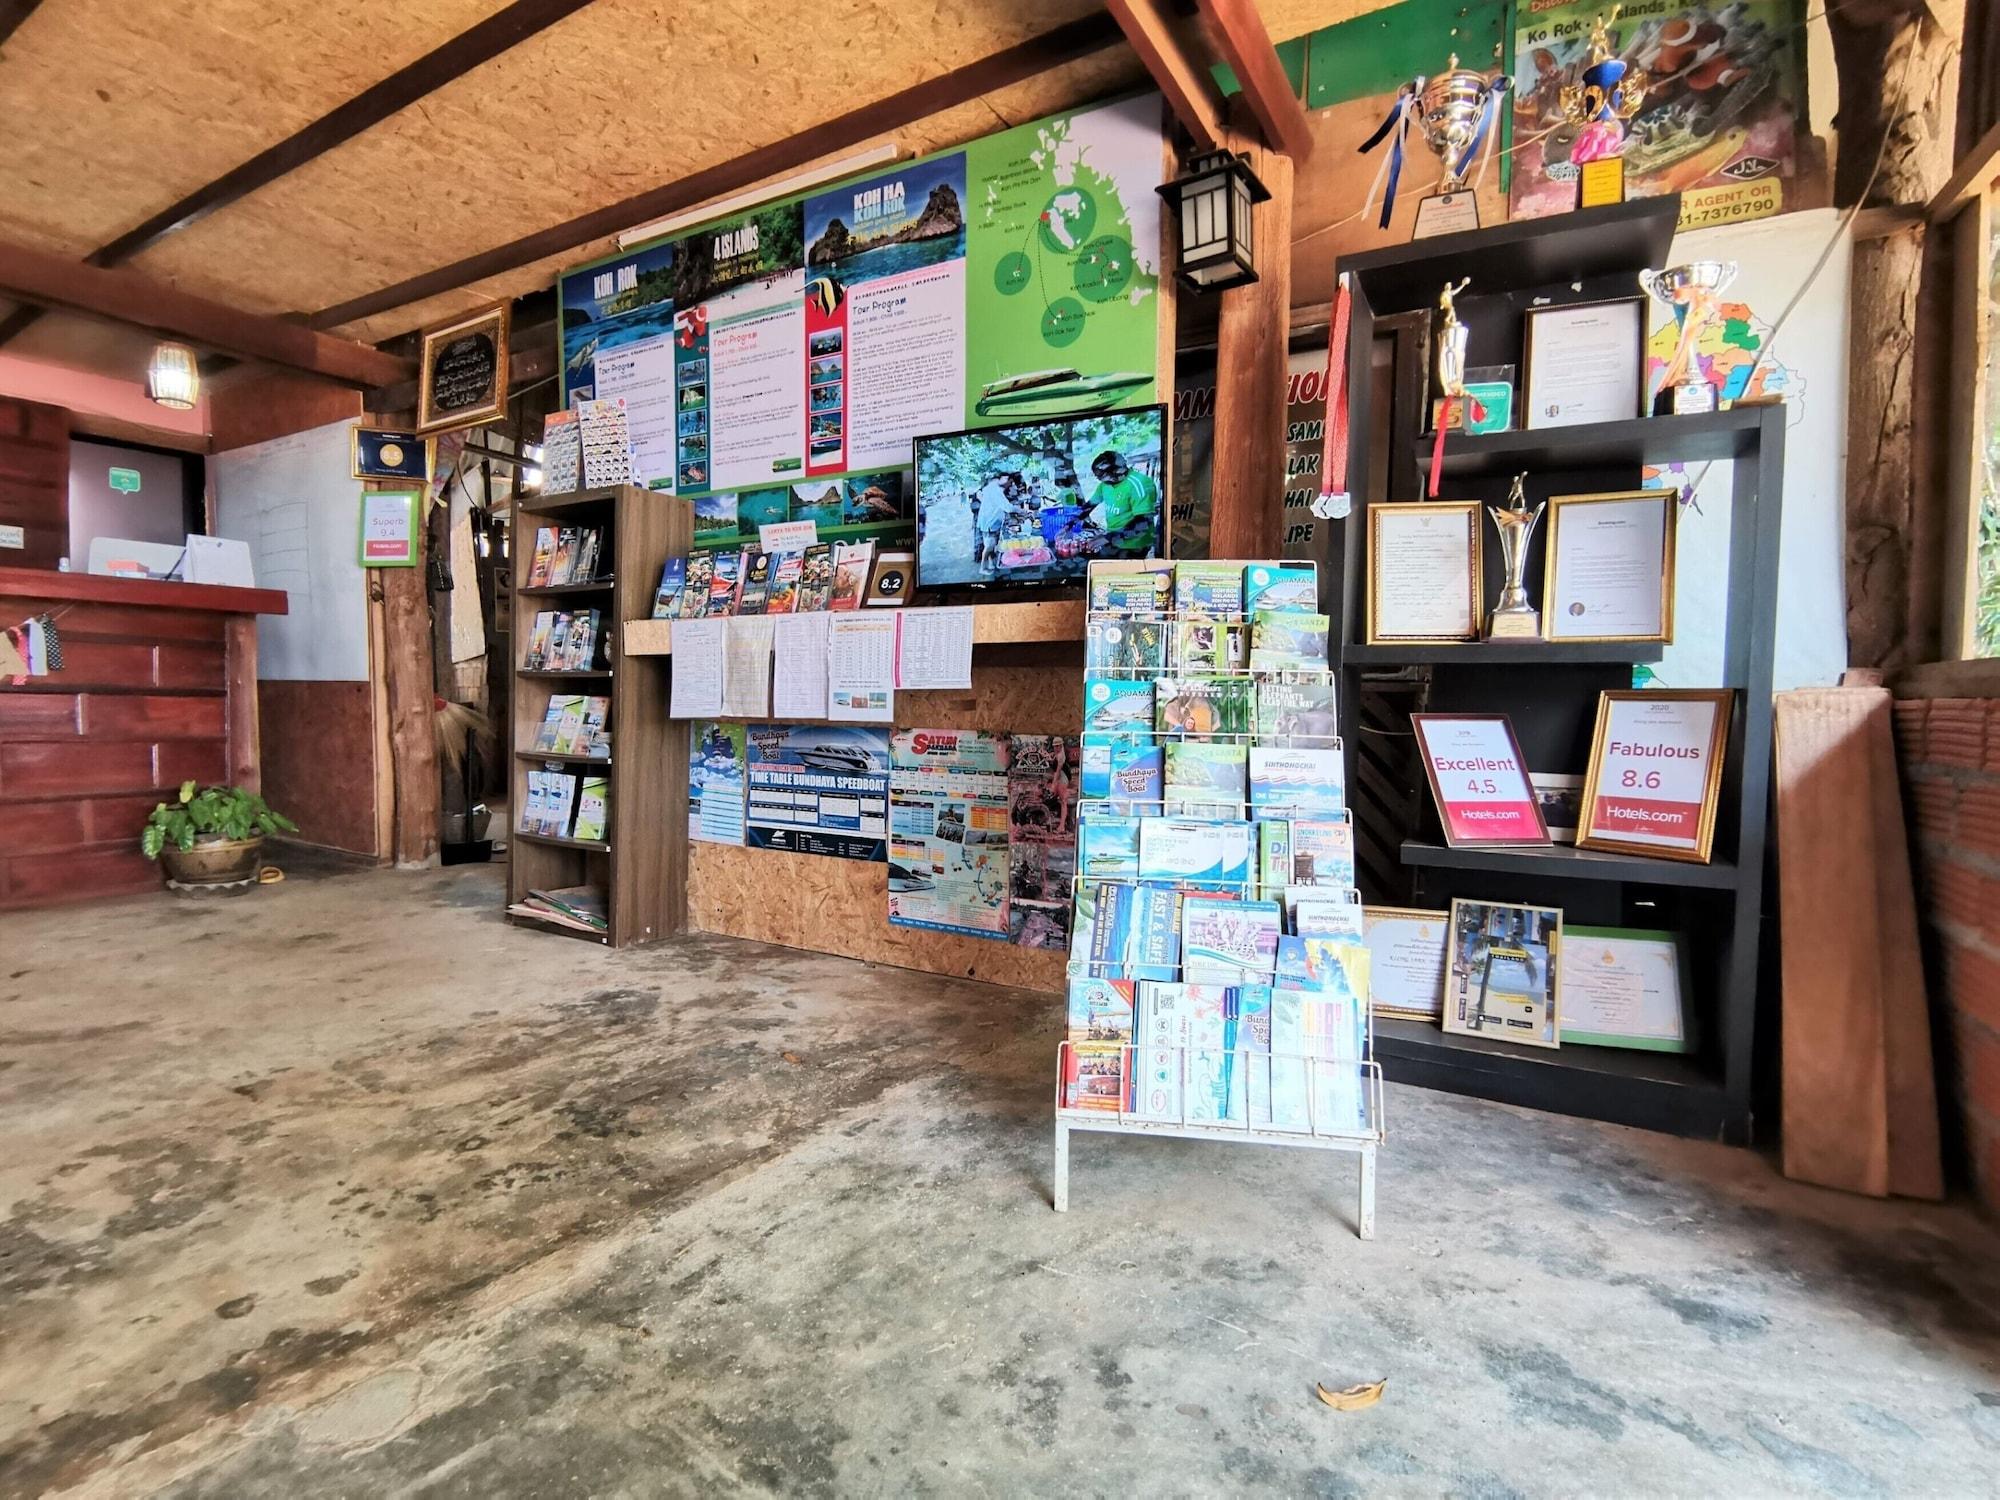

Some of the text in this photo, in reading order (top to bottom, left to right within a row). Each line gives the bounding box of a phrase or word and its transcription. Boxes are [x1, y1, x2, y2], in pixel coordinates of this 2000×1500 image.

[1528, 30, 1548, 44] Ko
[1554, 19, 1582, 37] Rok
[1616, 1, 1666, 21] slands
[854, 181, 905, 210] KOH HA
[1695, 190, 1744, 208] AGENT
[1750, 185, 1772, 197] OR
[854, 203, 881, 224] KOH
[714, 225, 759, 260] 4 ISLANDS
[594, 264, 638, 299] KOH ROK
[852, 297, 907, 315] Tour Program
[1286, 419, 1325, 444] SAM
[1288, 454, 1320, 476] LAK
[372, 517, 405, 527] Superb
[380, 528, 396, 537] 9.4
[1284, 524, 1316, 545] IPE
[881, 578, 901, 589] 8.2
[1114, 688, 1152, 697] AQUAMA
[751, 730, 790, 741] Bundhaya
[758, 740, 780, 752] Speed
[1609, 742, 1700, 759] Fabulous
[761, 751, 780, 760] Boat
[1116, 767, 1158, 778] Bundhaya
[1435, 757, 1516, 772] Excellent
[750, 772, 885, 792] TIME TABLE BUNDHAYA SPEEDBOAT
[1467, 779, 1497, 794] 4.5
[1621, 770, 1661, 788] 8.6
[1461, 809, 1521, 821] Hotels.com
[1606, 806, 1683, 823] Hotels.com
